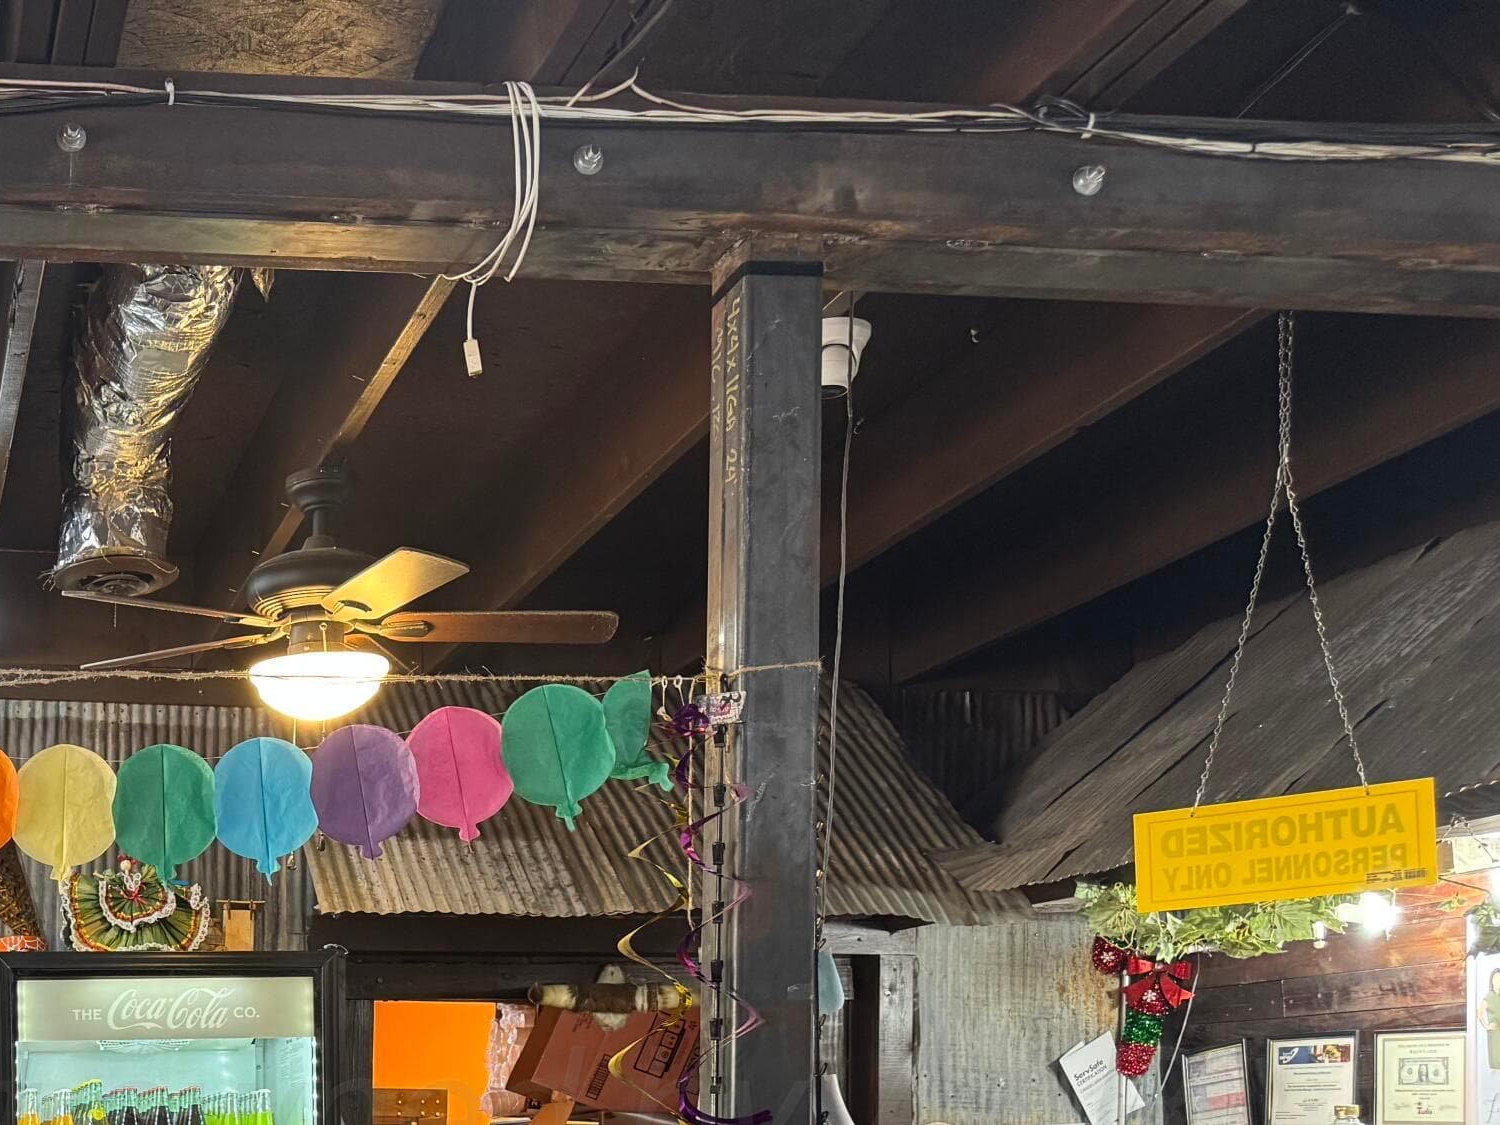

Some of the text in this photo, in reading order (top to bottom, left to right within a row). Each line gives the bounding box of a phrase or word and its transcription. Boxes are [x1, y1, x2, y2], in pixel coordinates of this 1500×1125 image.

[72, 1009, 102, 1020] THE
[233, 1006, 260, 1019] CO.
[1073, 1058, 1105, 1081] ServSafe
